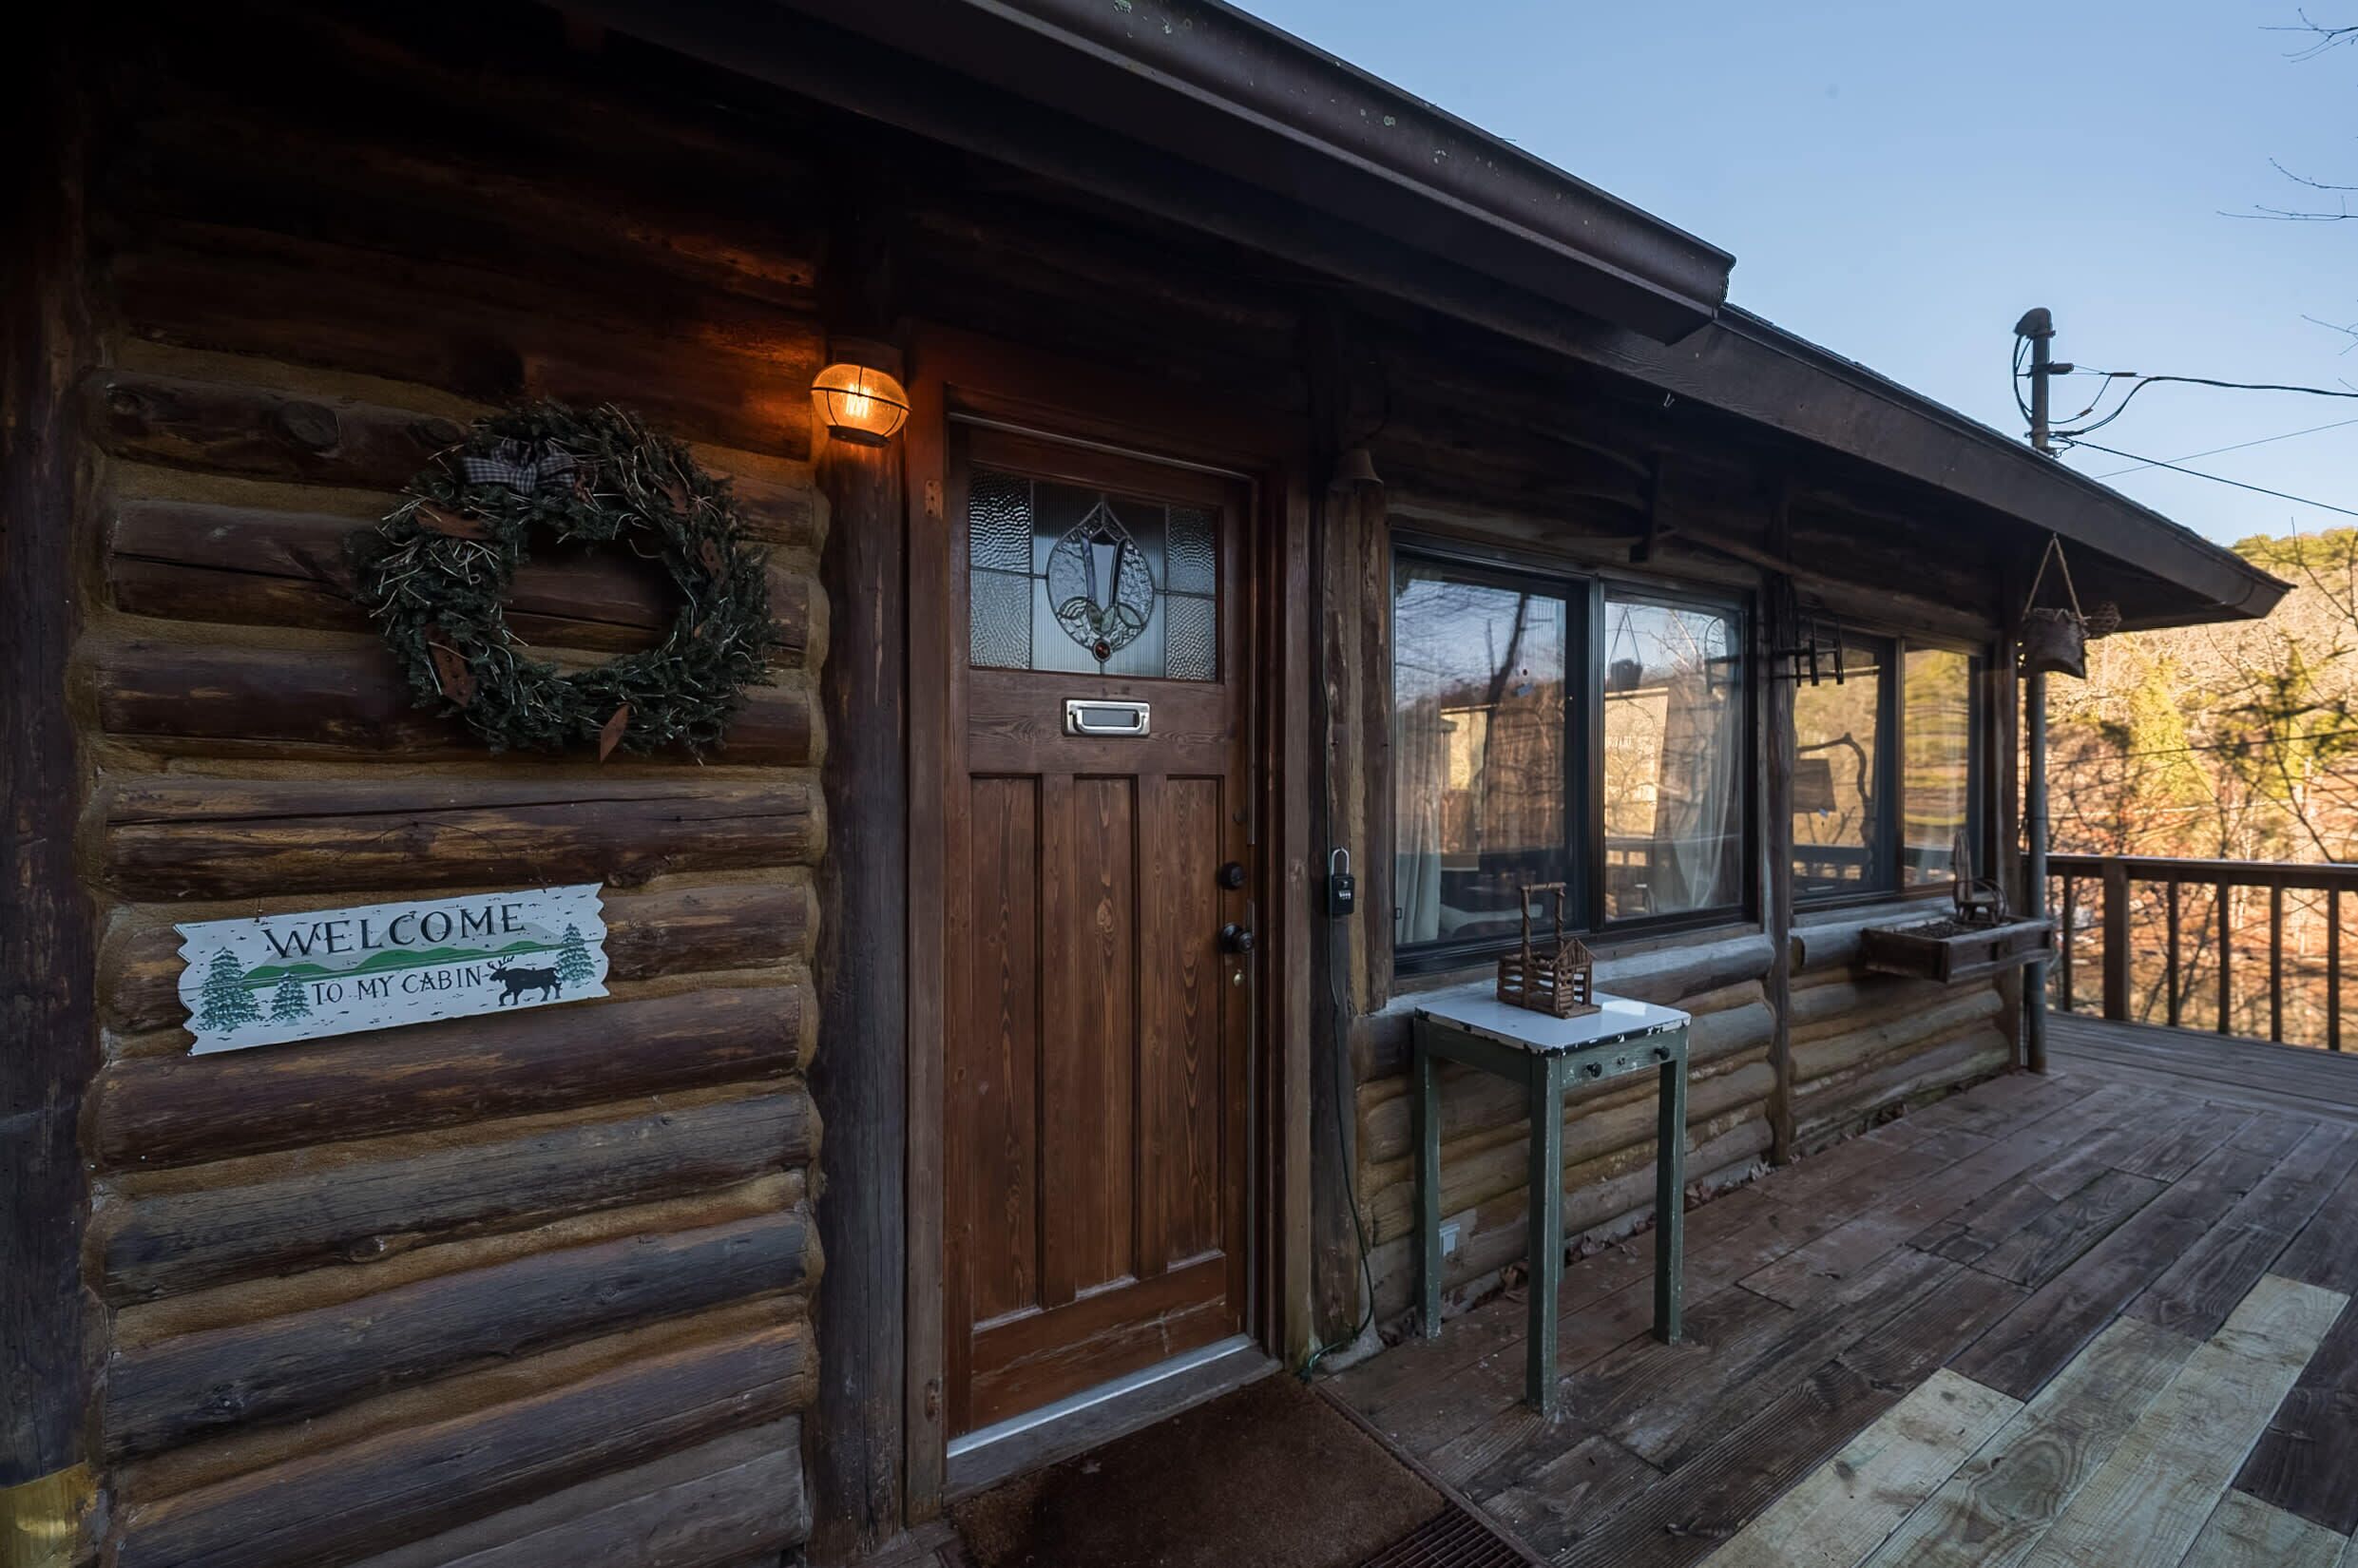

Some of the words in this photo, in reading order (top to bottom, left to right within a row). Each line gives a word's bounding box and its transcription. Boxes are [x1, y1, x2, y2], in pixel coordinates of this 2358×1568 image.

[261, 903, 526, 959] WELCOME
[312, 982, 343, 1005] TO
[357, 975, 394, 1001] MY
[402, 966, 482, 995] CABIN
